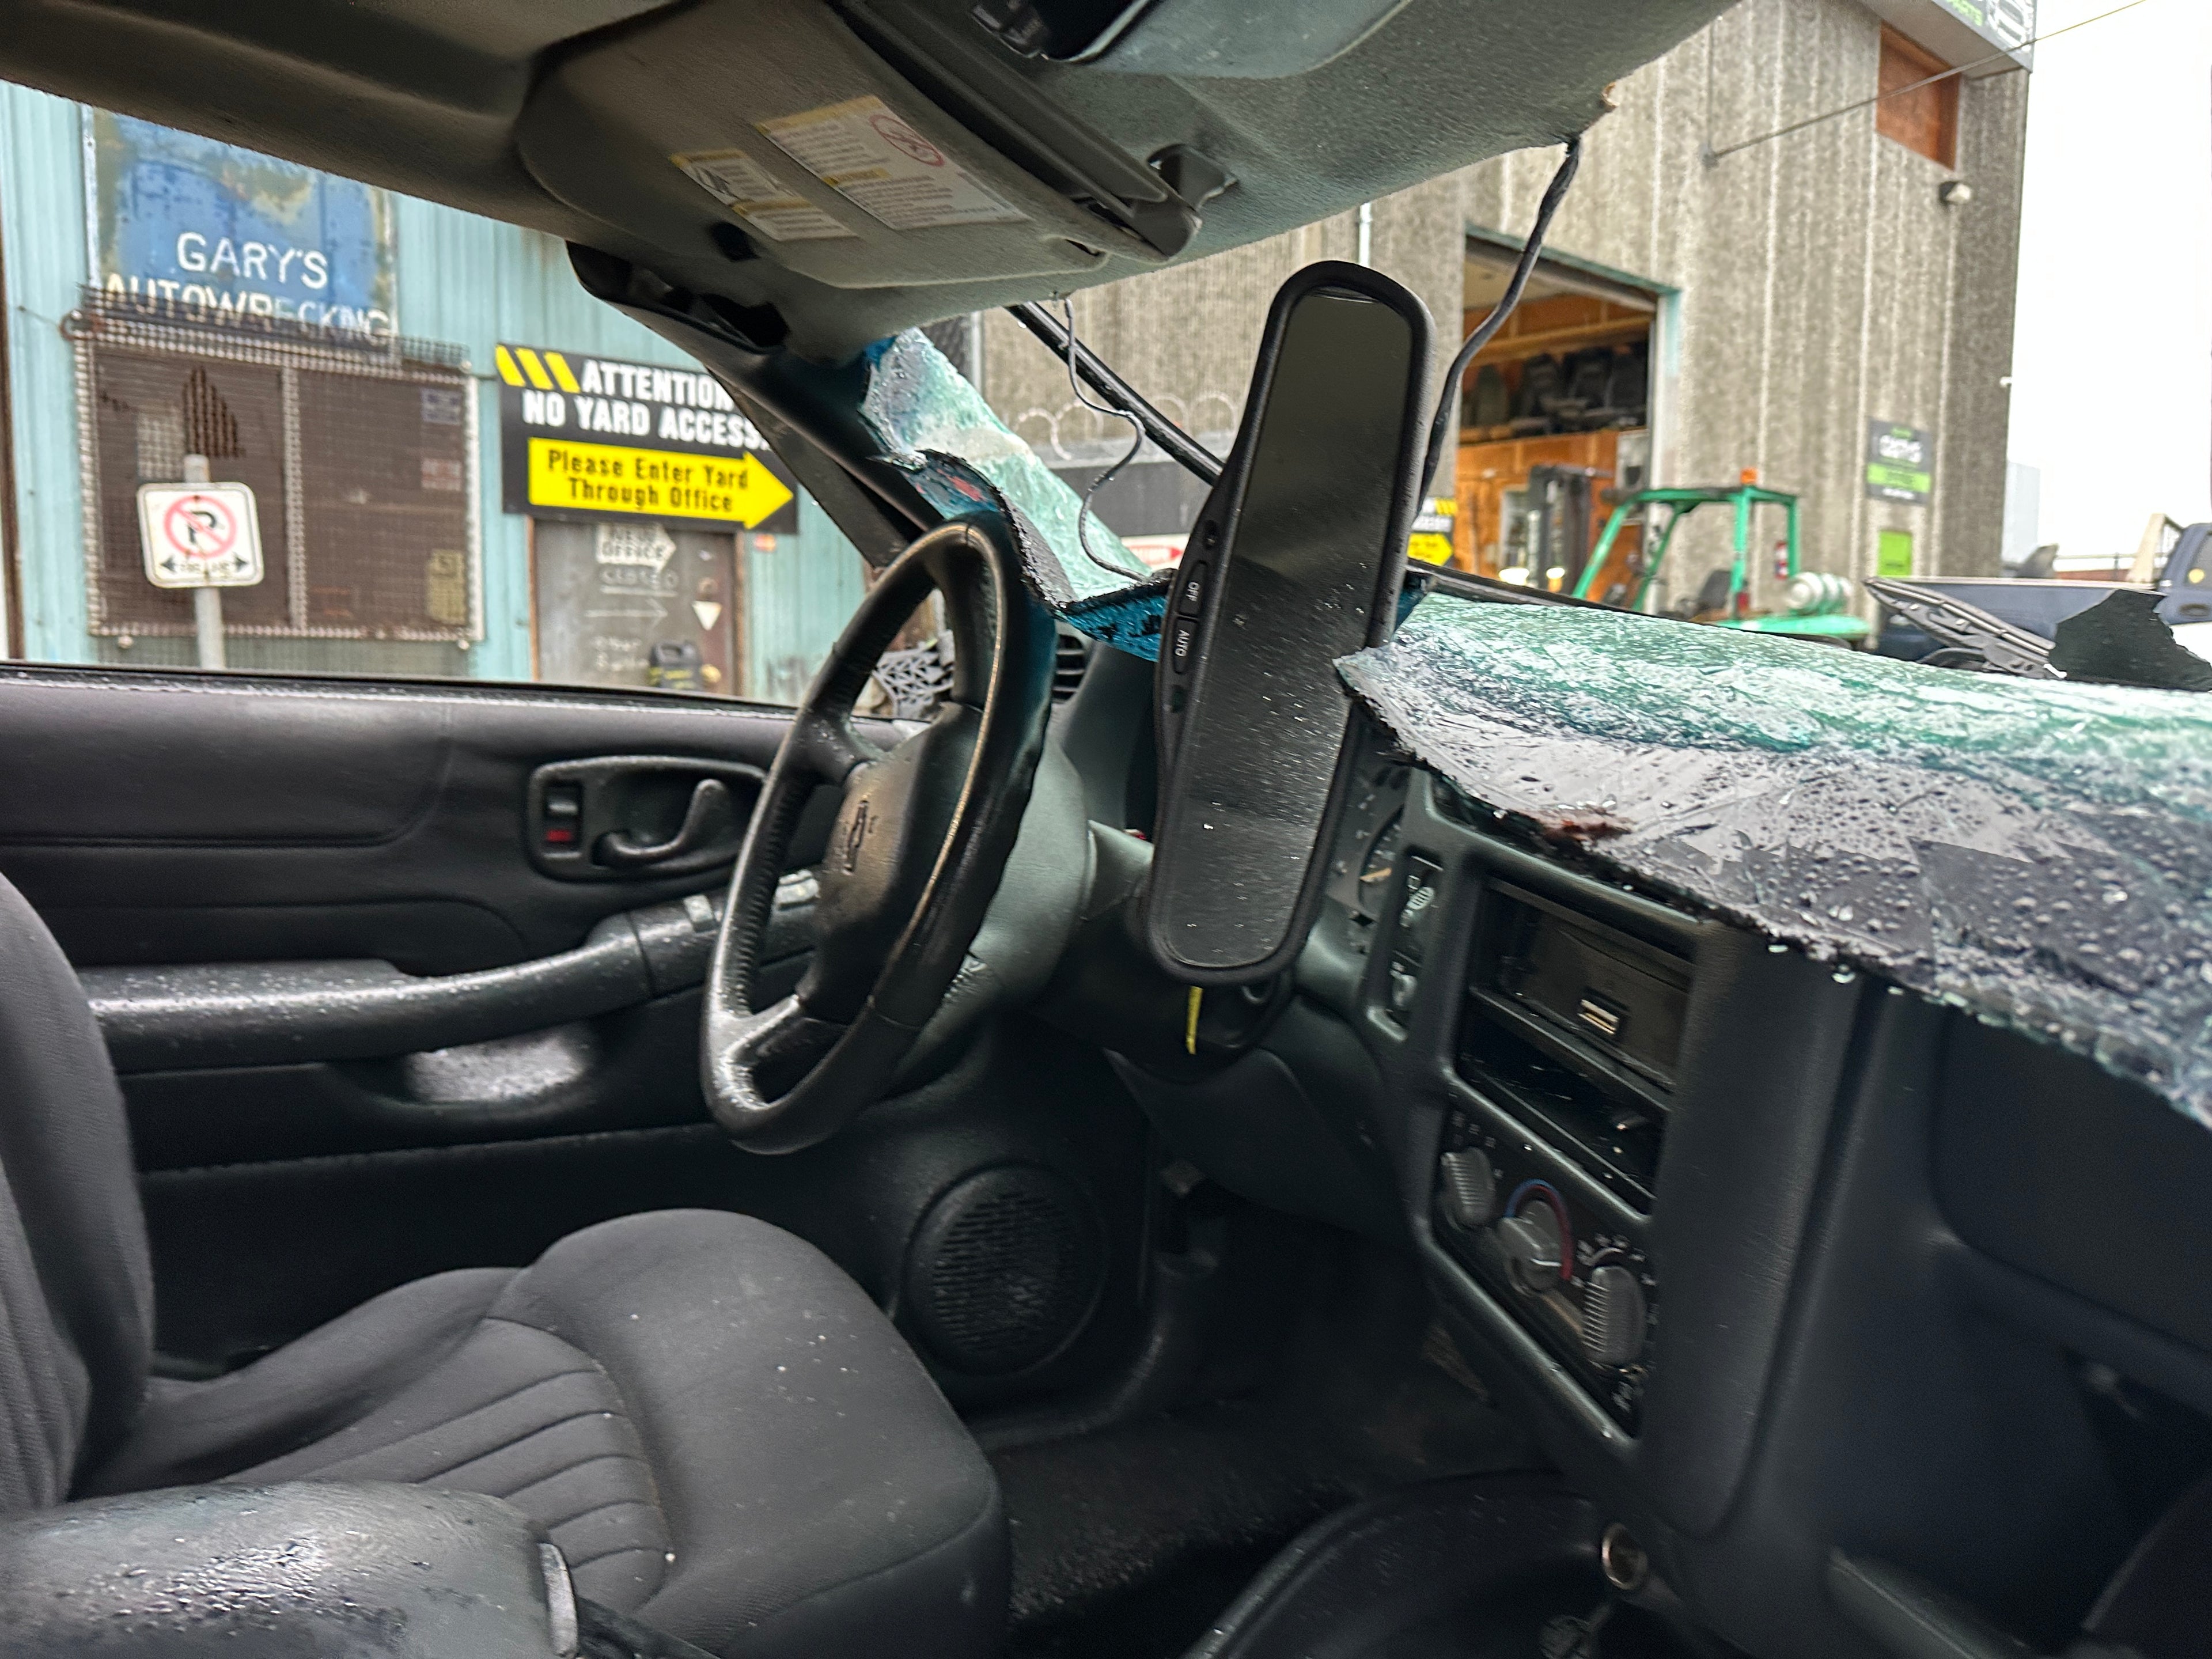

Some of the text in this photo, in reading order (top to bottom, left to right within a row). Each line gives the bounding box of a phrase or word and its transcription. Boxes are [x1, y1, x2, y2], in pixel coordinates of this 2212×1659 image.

[177, 232, 328, 289] GARY'S
[581, 359, 734, 411] ATTENTION
[522, 389, 566, 426] NO
[574, 395, 651, 436] YARD
[548, 448, 748, 490] Please Enter Yard
[567, 476, 733, 513] Through Office
[1186, 582, 1200, 602] OFF
[1175, 629, 1190, 657] AUTO
